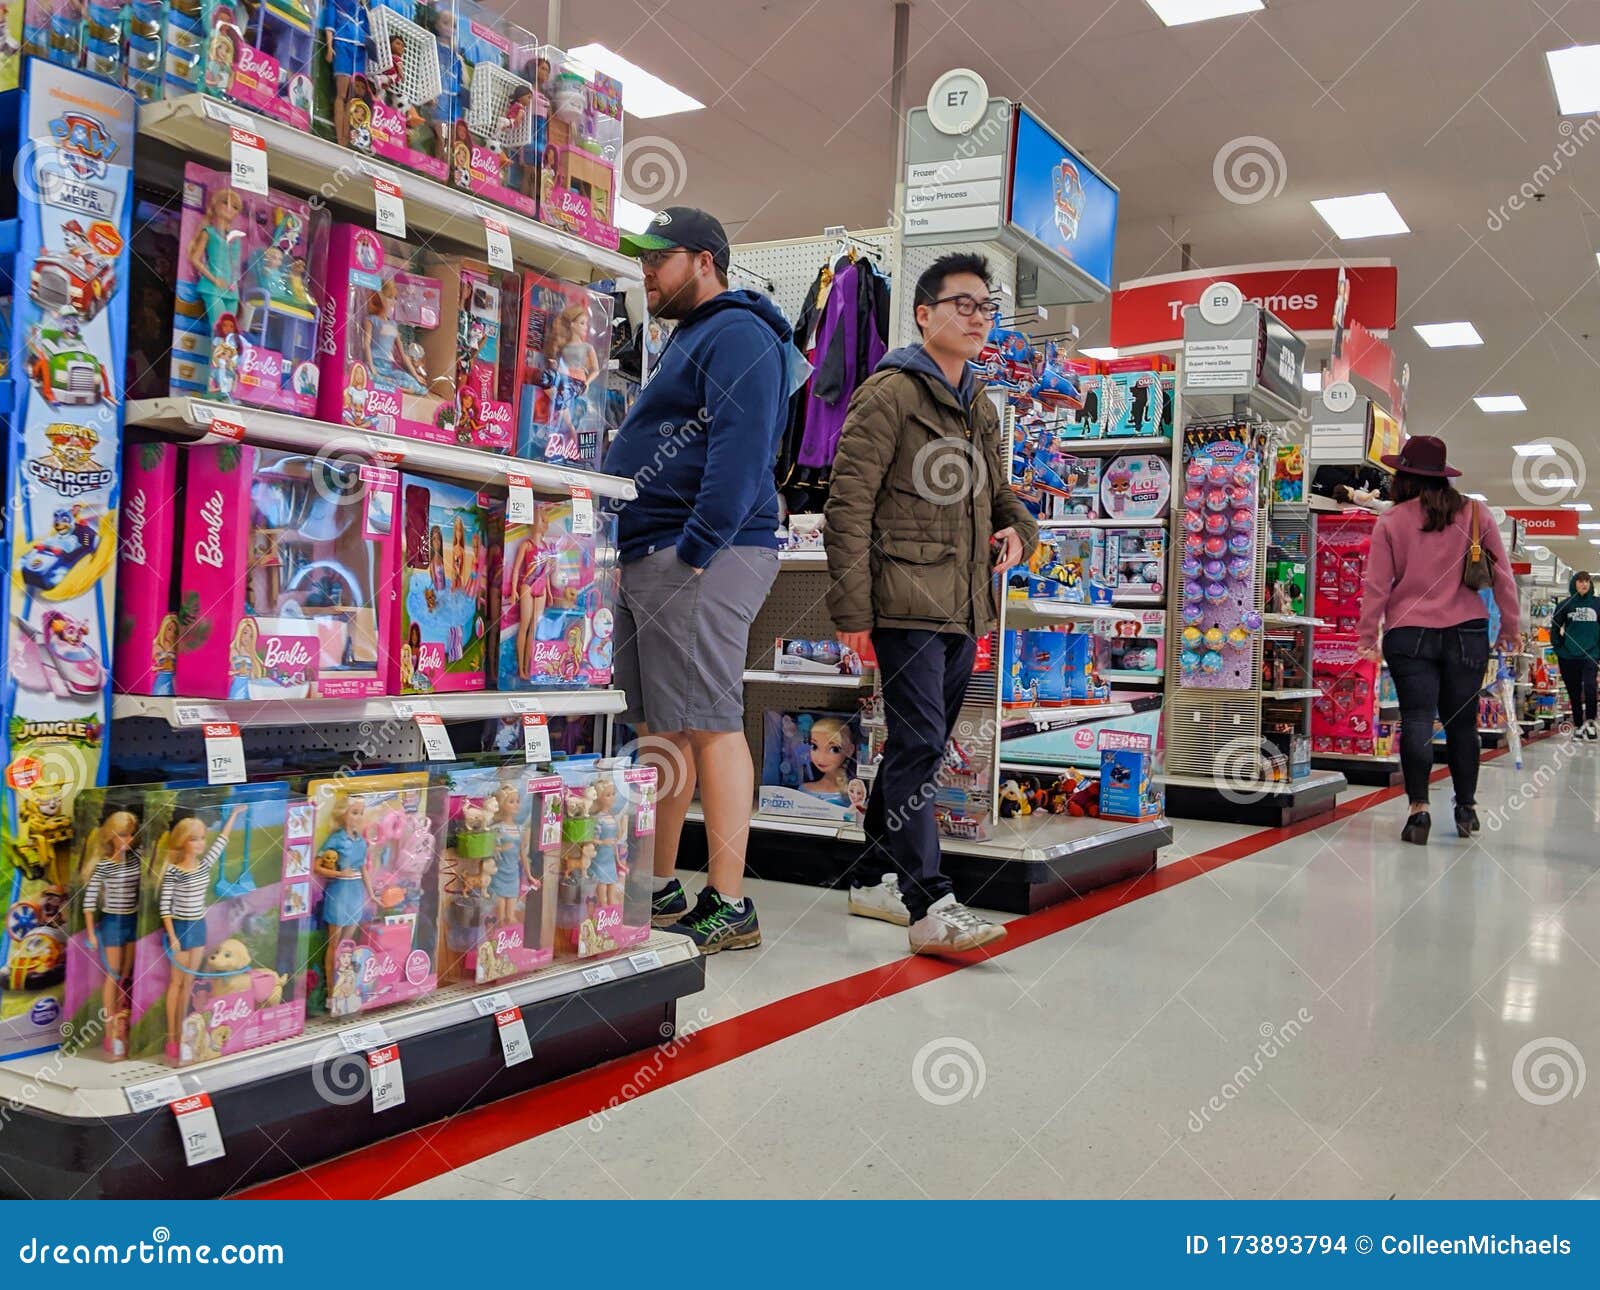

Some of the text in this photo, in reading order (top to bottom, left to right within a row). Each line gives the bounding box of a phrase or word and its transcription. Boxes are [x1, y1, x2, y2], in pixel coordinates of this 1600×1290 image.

[239, 49, 278, 83] Barbie
[947, 91, 969, 107] E7
[372, 106, 405, 137] Barbie
[231, 129, 257, 146] Sale!
[471, 147, 500, 175] Barbie
[63, 183, 99, 201] TRUE
[374, 179, 396, 196] Sale!
[936, 191, 968, 200] Princess
[59, 192, 105, 214] METAL
[562, 193, 588, 218] Barbie
[910, 219, 929, 227] Trolls
[1213, 296, 1229, 307] E9
[320, 297, 337, 356] Barbie
[243, 350, 281, 377] Barbie
[367, 392, 400, 415] Barbie
[1331, 390, 1348, 400] E11
[480, 401, 511, 422] Barbie
[212, 420, 238, 438] Sale!
[545, 433, 580, 460] Barbie
[29, 460, 112, 484] CHARGED
[509, 475, 527, 486] Sale!
[58, 483, 82, 497] UP
[571, 488, 588, 498] Sale!
[122, 488, 147, 566] Barbie
[195, 490, 224, 569] Barbie
[1519, 518, 1556, 528] Goods
[264, 637, 312, 668] Barbie
[418, 644, 442, 670] Barbie
[534, 643, 562, 662] Barbie
[18, 720, 87, 739] JUNGLE
[524, 715, 541, 726] Sale!
[206, 725, 232, 737] Sale!
[761, 797, 794, 810] FROZEN
[597, 911, 622, 932] Barbie
[496, 931, 522, 953] Barbie
[363, 957, 397, 983] Barbie
[210, 997, 252, 1028] Barbie
[497, 1011, 516, 1025] Sale!
[370, 1049, 393, 1067] Sale!
[172, 1096, 203, 1115] Sale!
